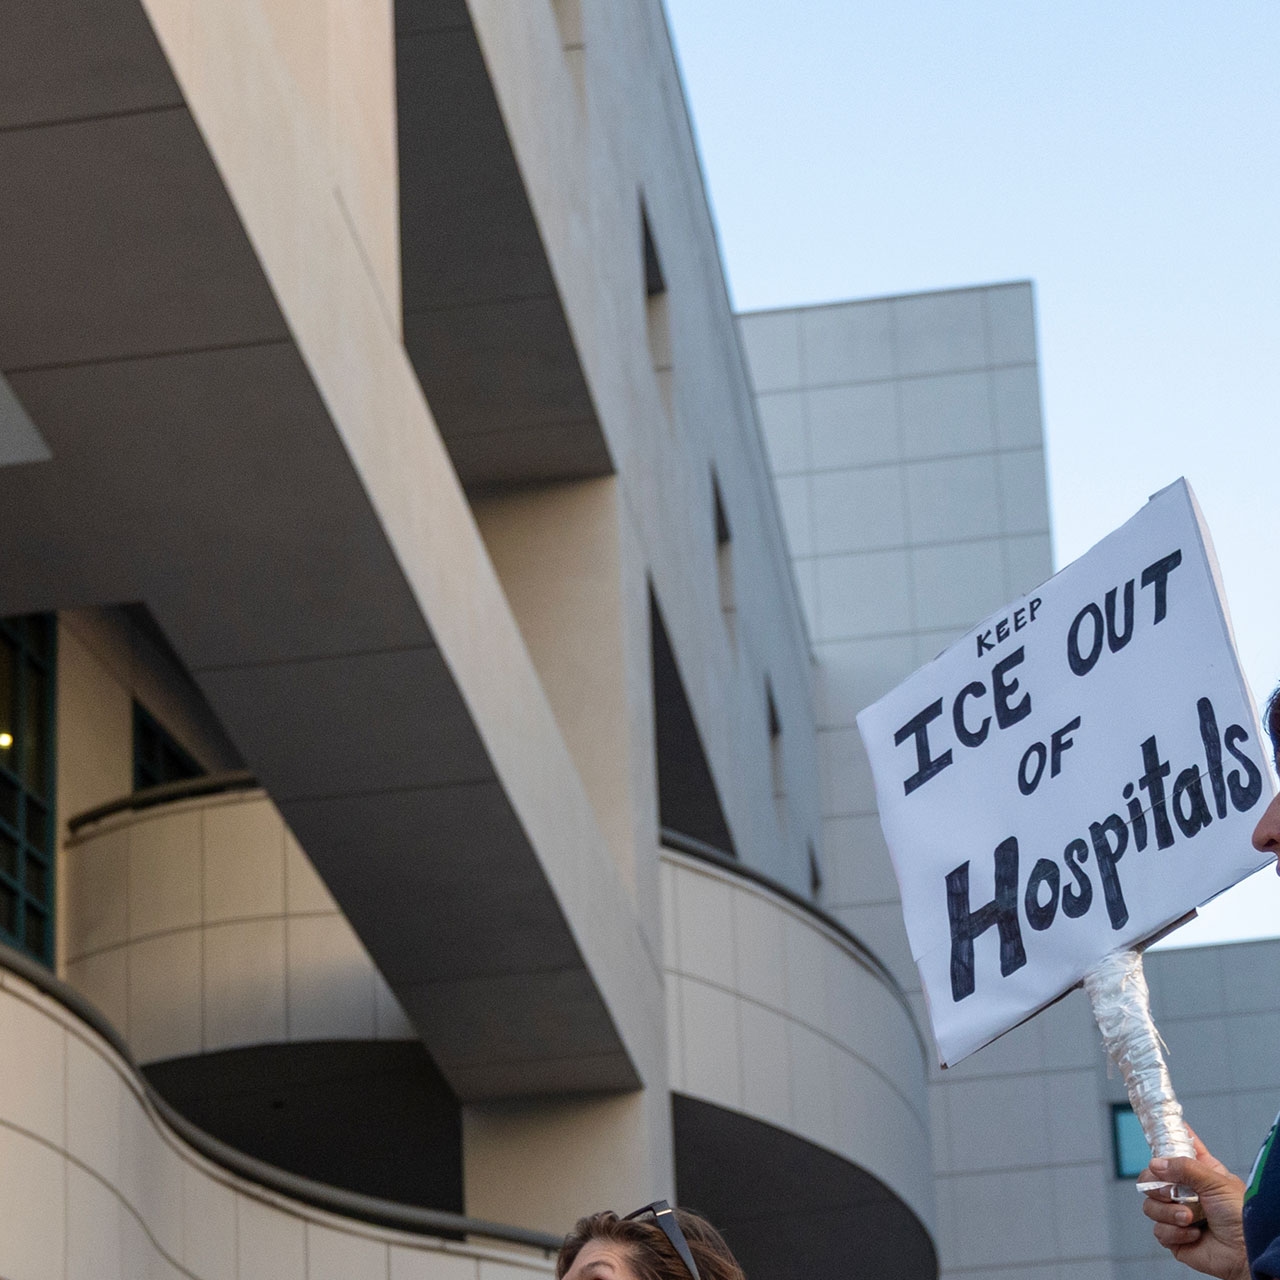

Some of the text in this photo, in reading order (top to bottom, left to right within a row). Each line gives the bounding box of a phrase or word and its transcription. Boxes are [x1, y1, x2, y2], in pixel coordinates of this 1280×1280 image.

[893, 548, 1183, 797] ICE OUT
[976, 597, 1042, 658] KEEP
[1018, 715, 1081, 796] OF
[945, 696, 1263, 1003] Hospitals
